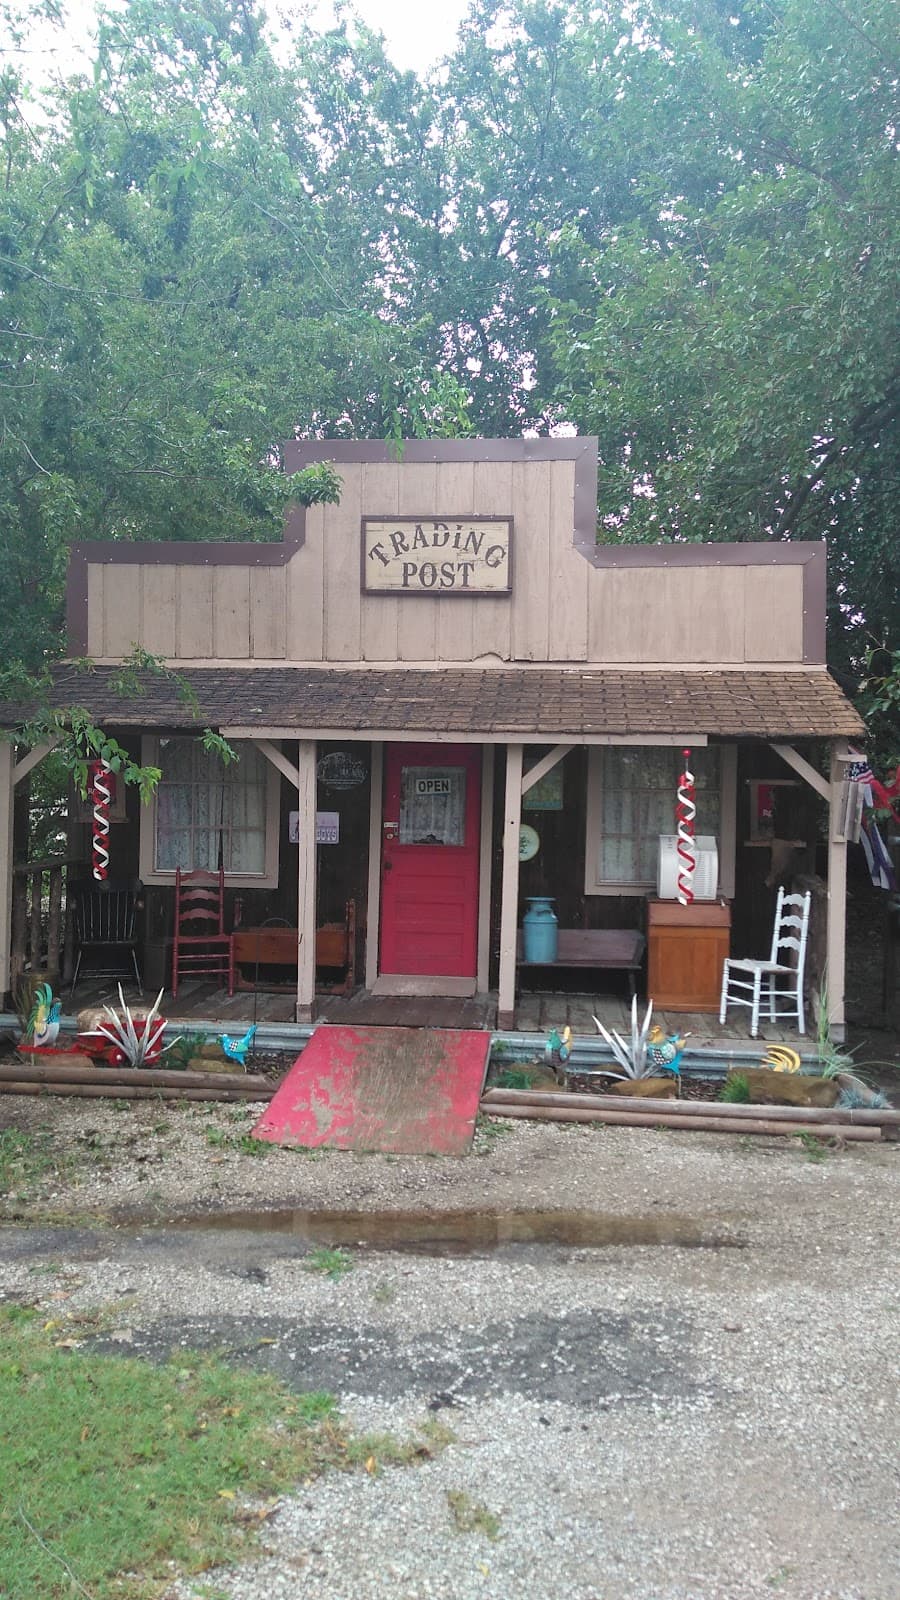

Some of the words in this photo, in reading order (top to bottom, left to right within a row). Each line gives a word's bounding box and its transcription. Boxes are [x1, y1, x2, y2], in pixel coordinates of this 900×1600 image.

[368, 522, 506, 568] TRADING
[401, 562, 475, 588] POST
[418, 780, 449, 793] OPEN
